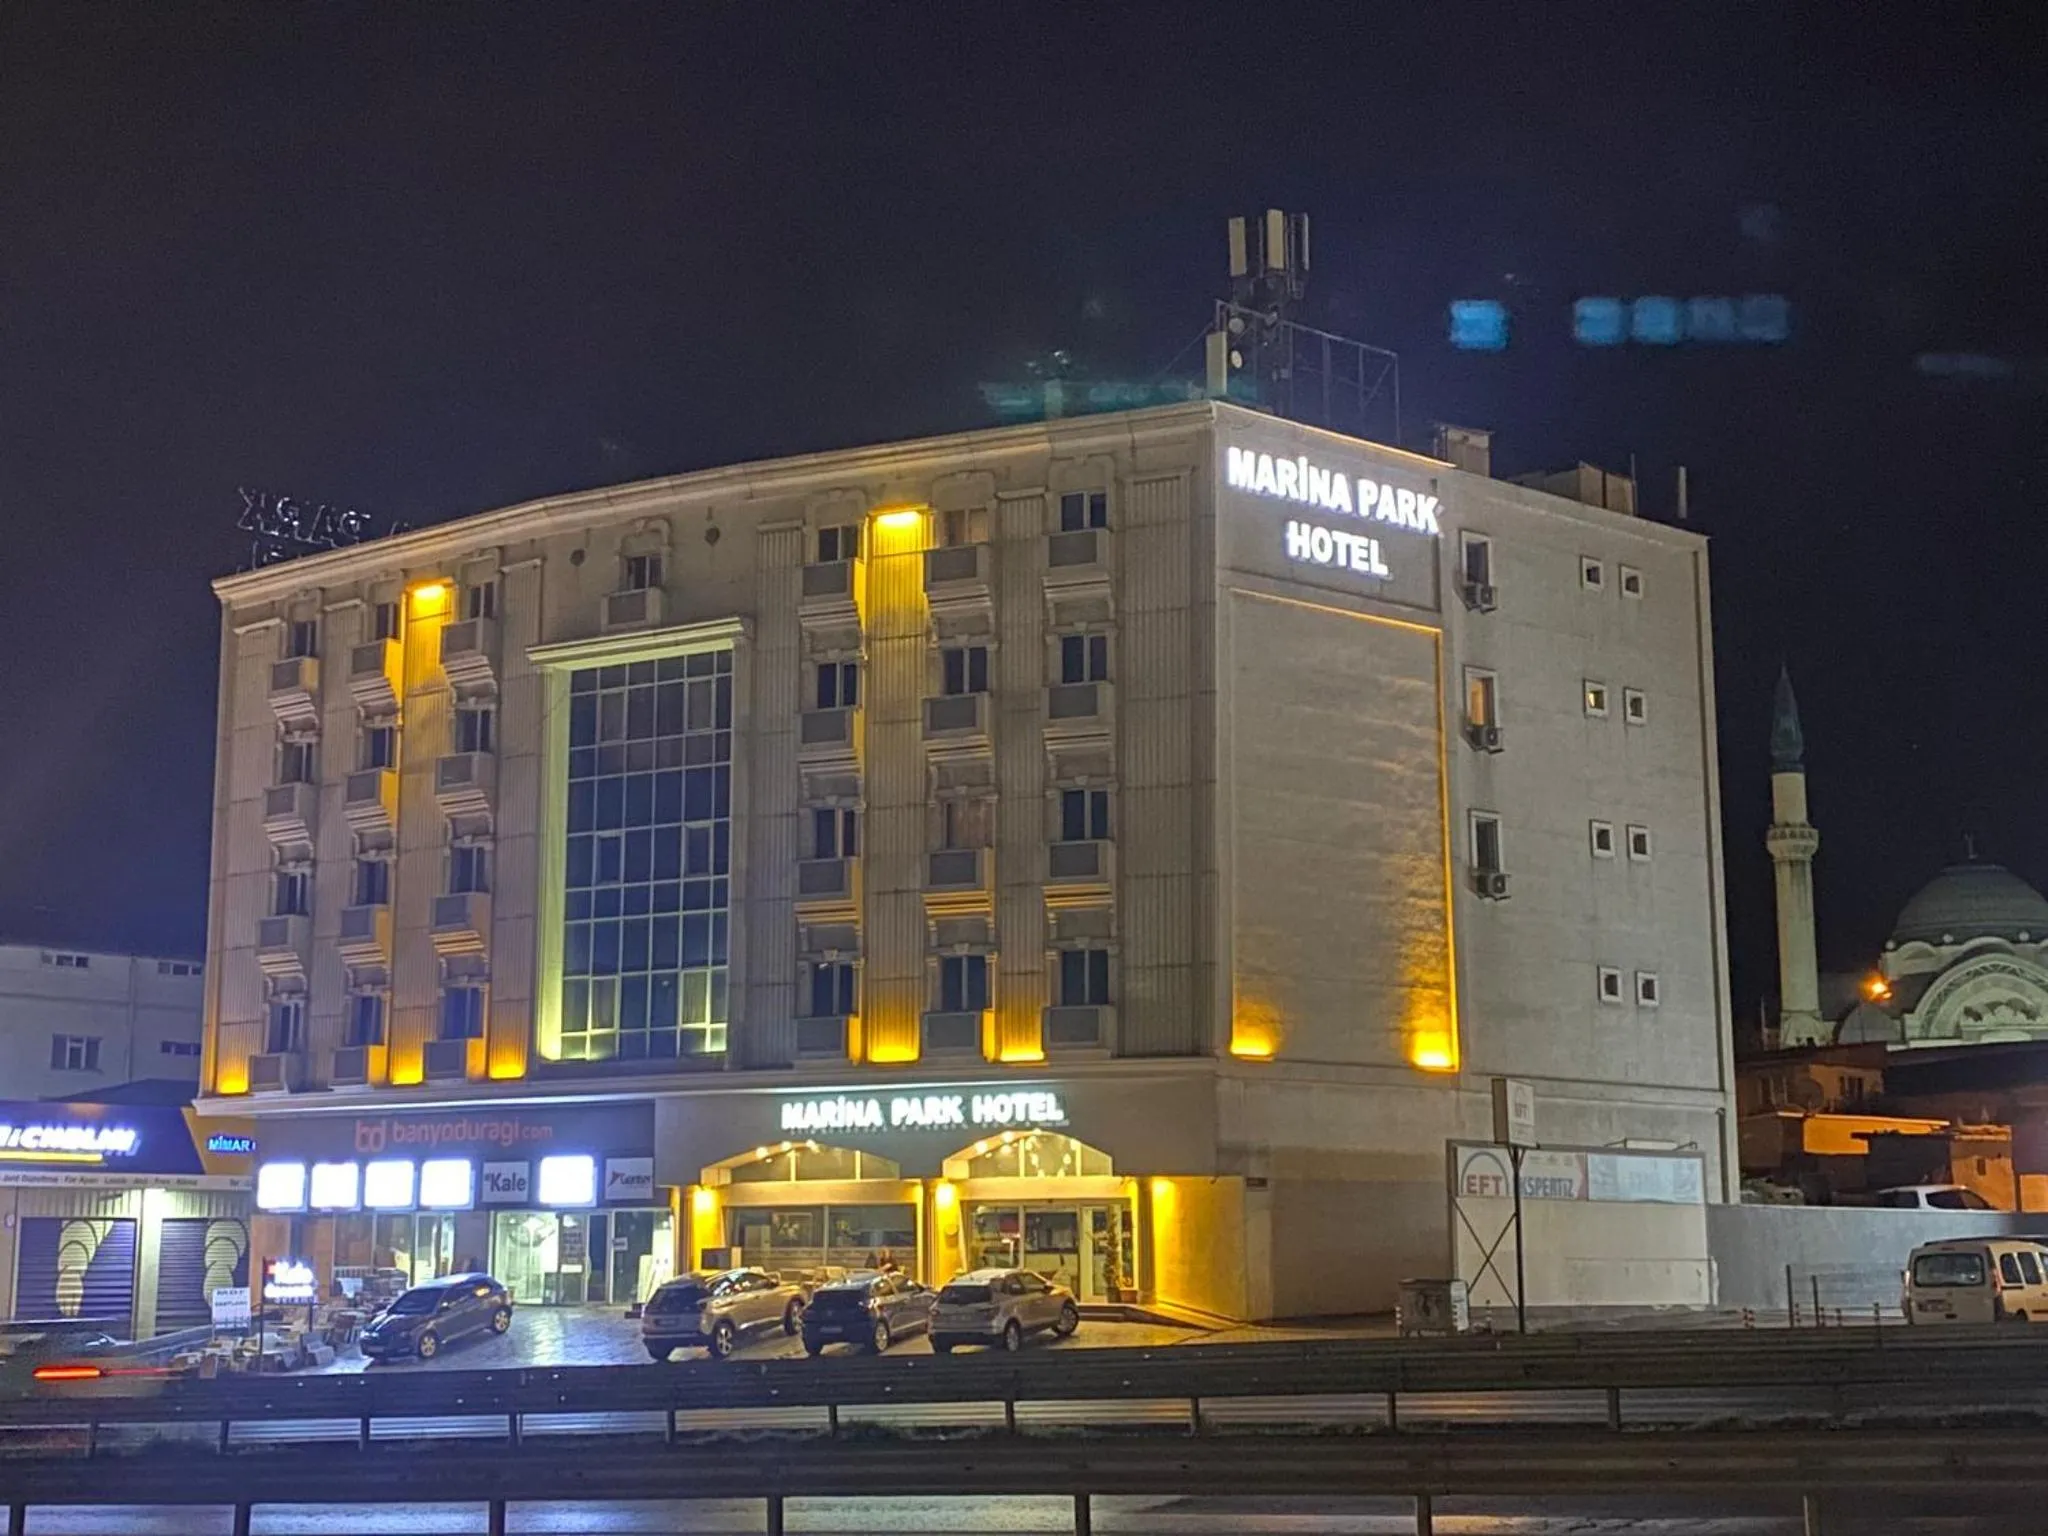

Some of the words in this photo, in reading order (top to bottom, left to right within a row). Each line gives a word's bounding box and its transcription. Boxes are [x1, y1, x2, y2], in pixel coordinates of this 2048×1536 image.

[1357, 477, 1441, 536] PARK
[1287, 520, 1389, 577] HOTEL
[890, 1096, 966, 1127] PARK
[971, 1092, 1065, 1124] HOTEL
[489, 1171, 527, 1193] Kale
[1465, 1174, 1503, 1196] EFT
